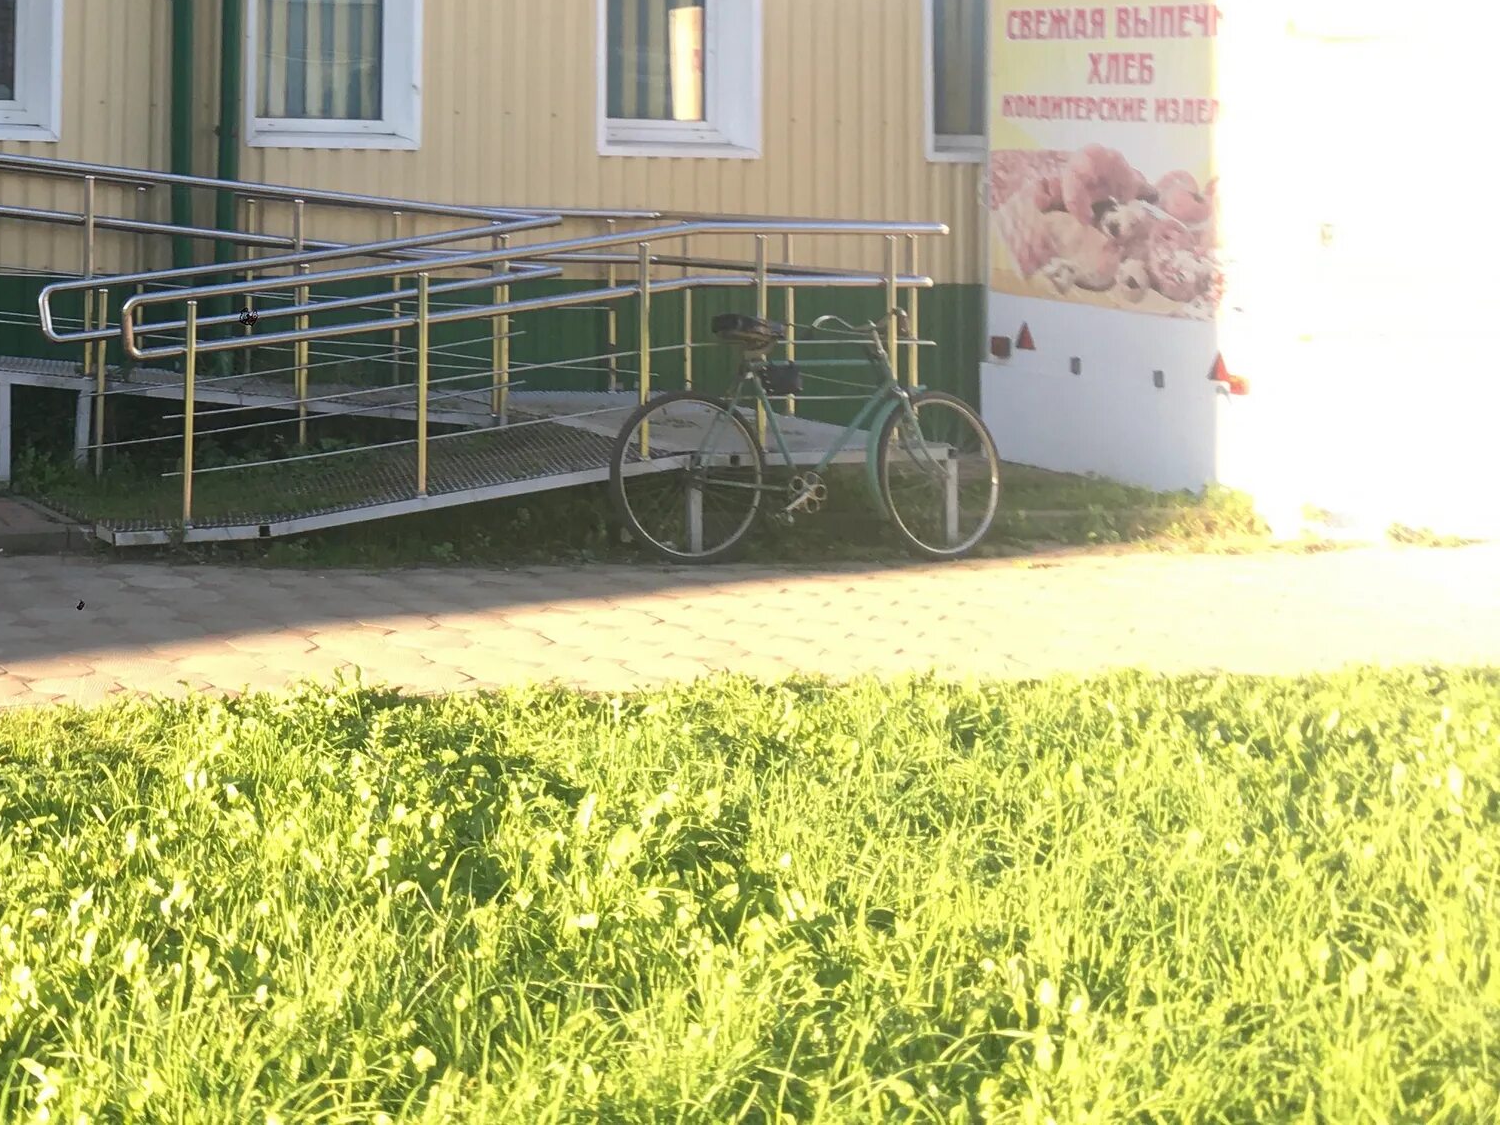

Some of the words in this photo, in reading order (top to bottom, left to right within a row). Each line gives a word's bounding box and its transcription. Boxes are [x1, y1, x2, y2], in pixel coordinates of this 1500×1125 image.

[1006, 7, 1107, 41] СВЕЖАЯ
[1087, 51, 1156, 86] ХЛЕБ
[1002, 94, 1148, 123] КОНДИТЕРСКИЕ
